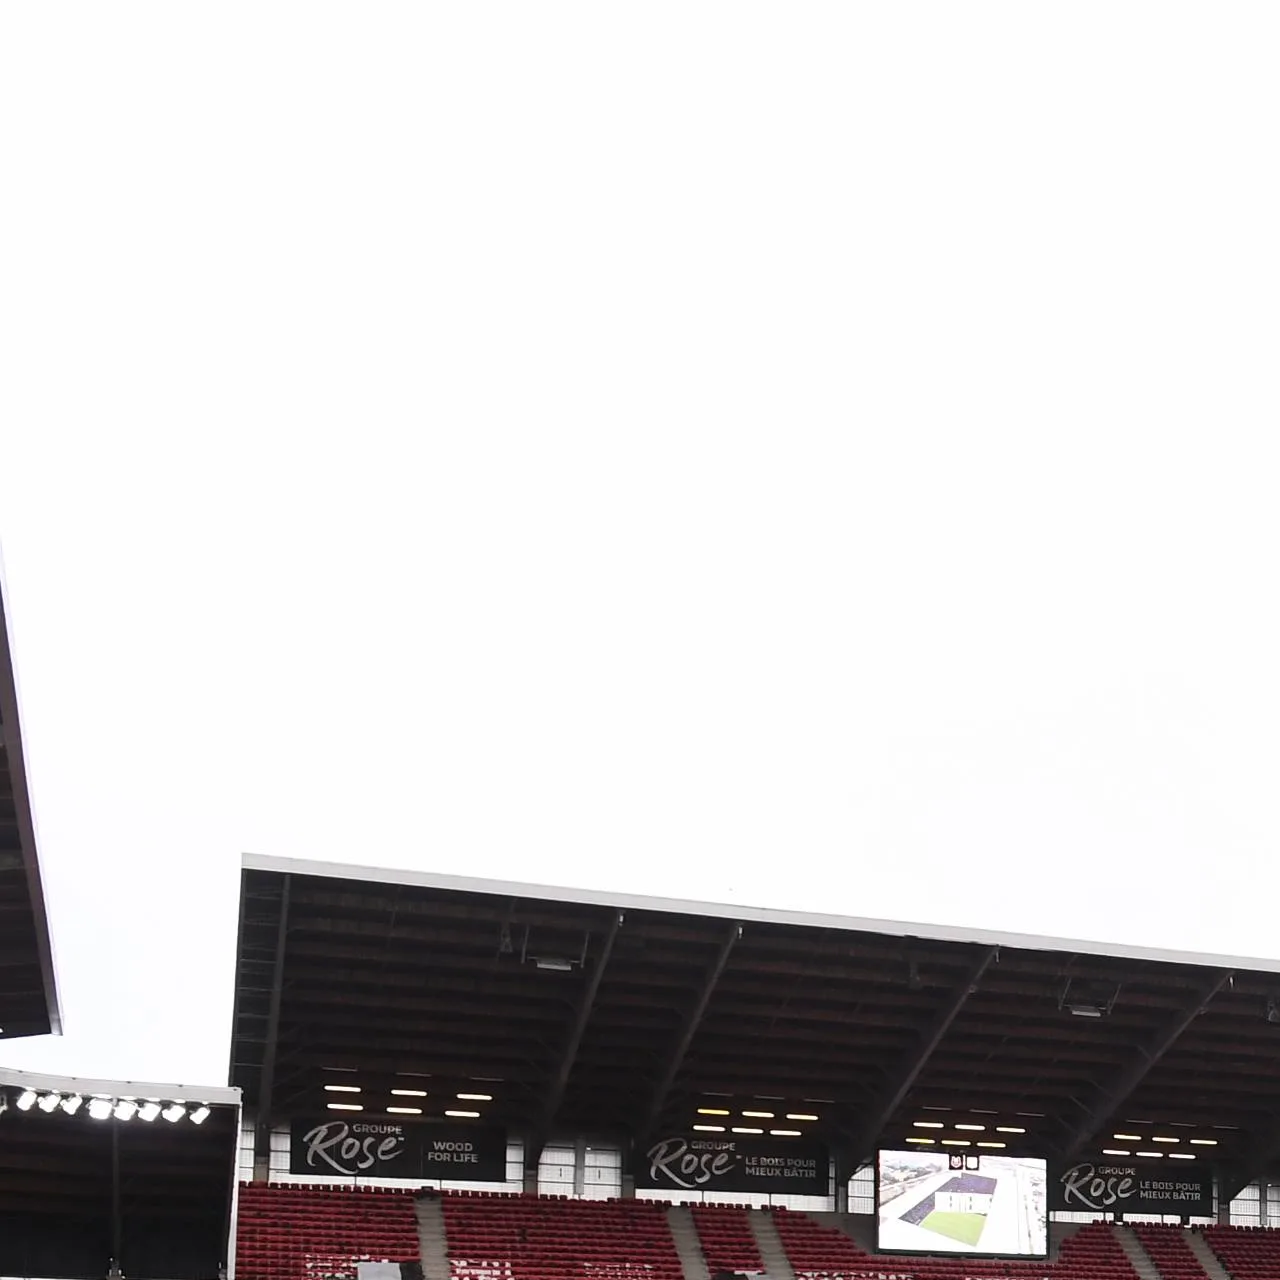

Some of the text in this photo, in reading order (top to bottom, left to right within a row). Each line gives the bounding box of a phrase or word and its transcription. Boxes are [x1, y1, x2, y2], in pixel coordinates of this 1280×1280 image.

[352, 1123, 402, 1135] GROUPE
[433, 1141, 473, 1151] WOOD
[691, 1140, 736, 1151] GROUPE
[428, 1152, 479, 1163] FOR LIFE
[745, 1157, 816, 1168] LE BOIS POUR
[745, 1166, 782, 1177] MIEUX
[1100, 1166, 1136, 1175] GROUPE
[1139, 1181, 1201, 1191] LE BOIS POUR
[1140, 1191, 1171, 1200] MIEUX
